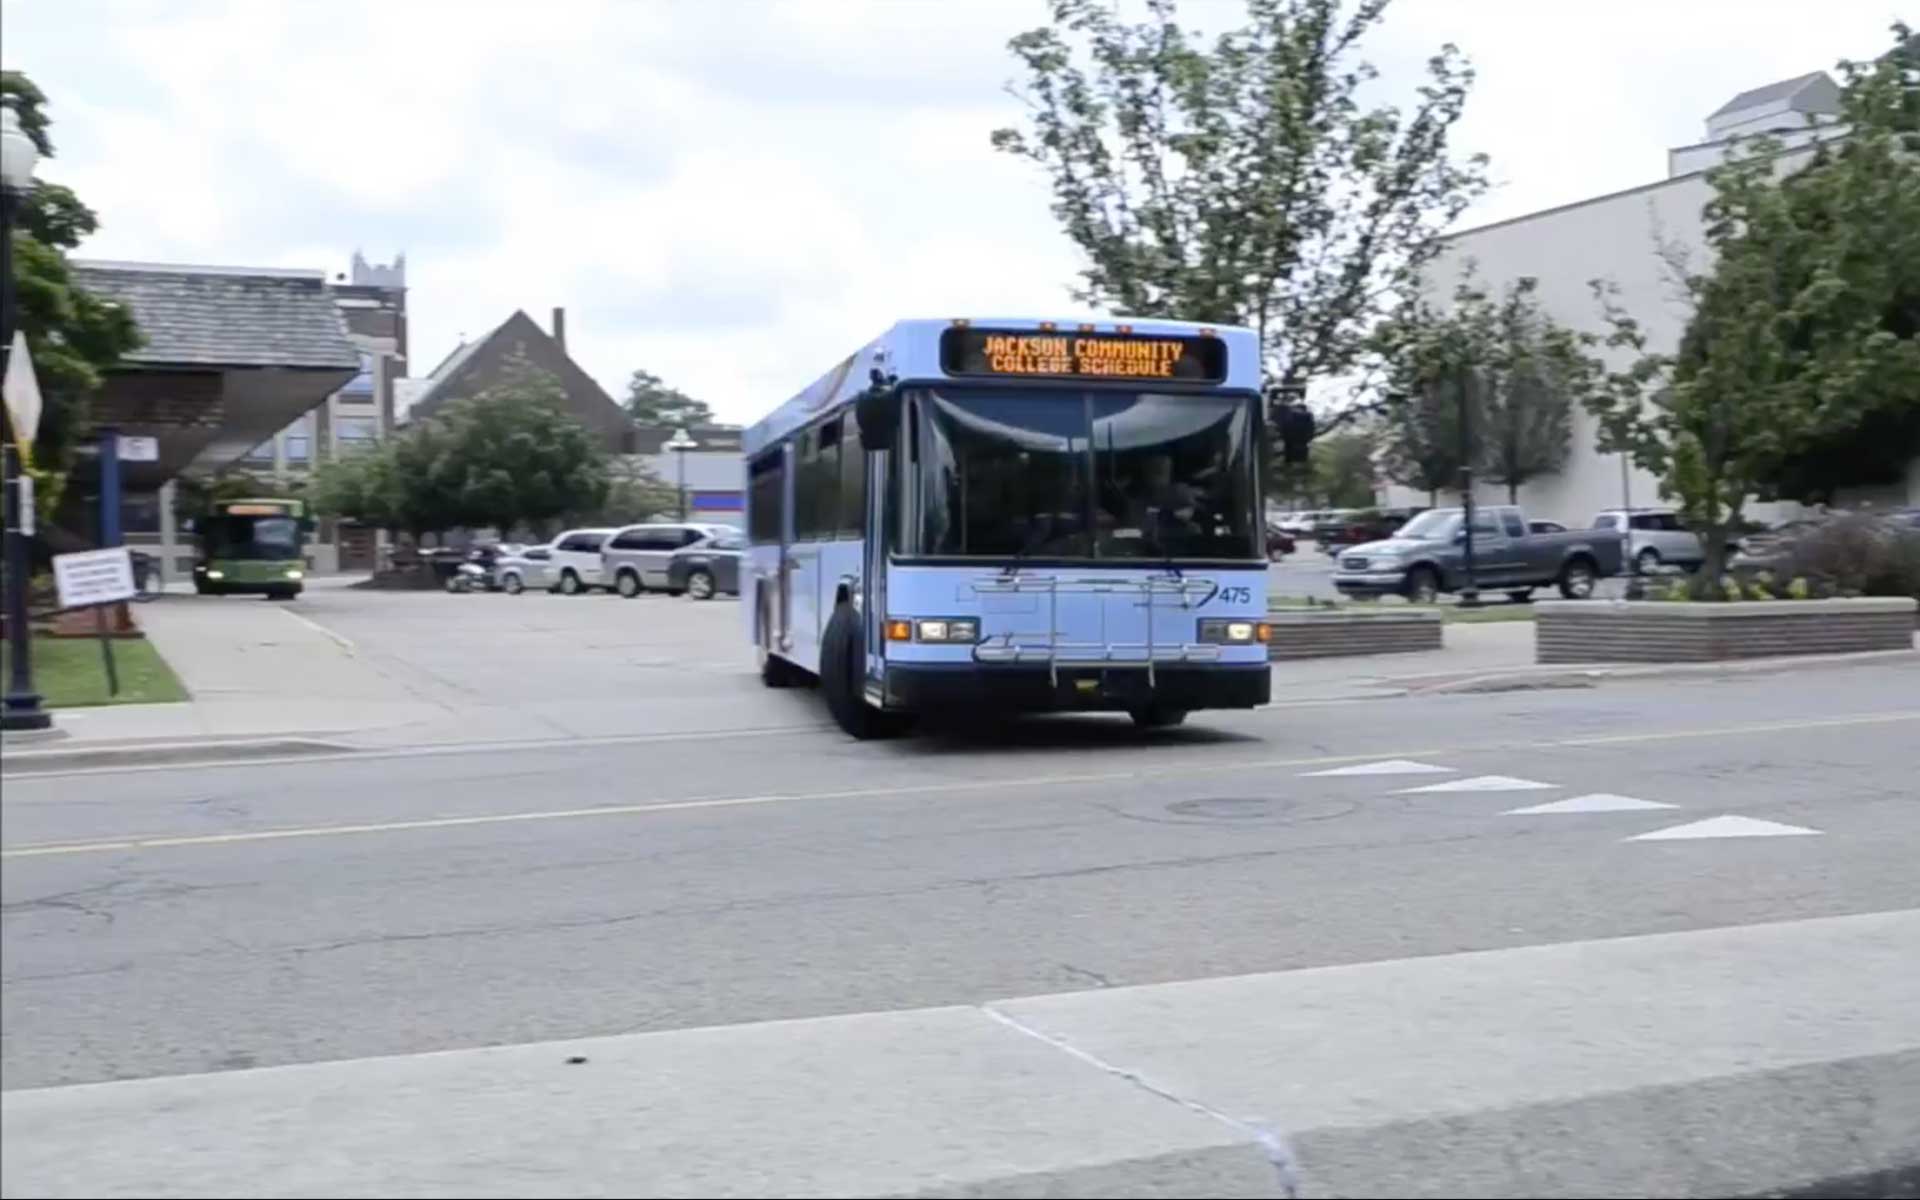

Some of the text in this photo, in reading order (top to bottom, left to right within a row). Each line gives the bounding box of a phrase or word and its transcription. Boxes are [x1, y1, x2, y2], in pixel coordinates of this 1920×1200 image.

[983, 336, 1183, 360] JACKSON COMMUNITY
[992, 355, 1173, 376] COLLEGE SCHEDULE
[1219, 586, 1251, 604] 475
